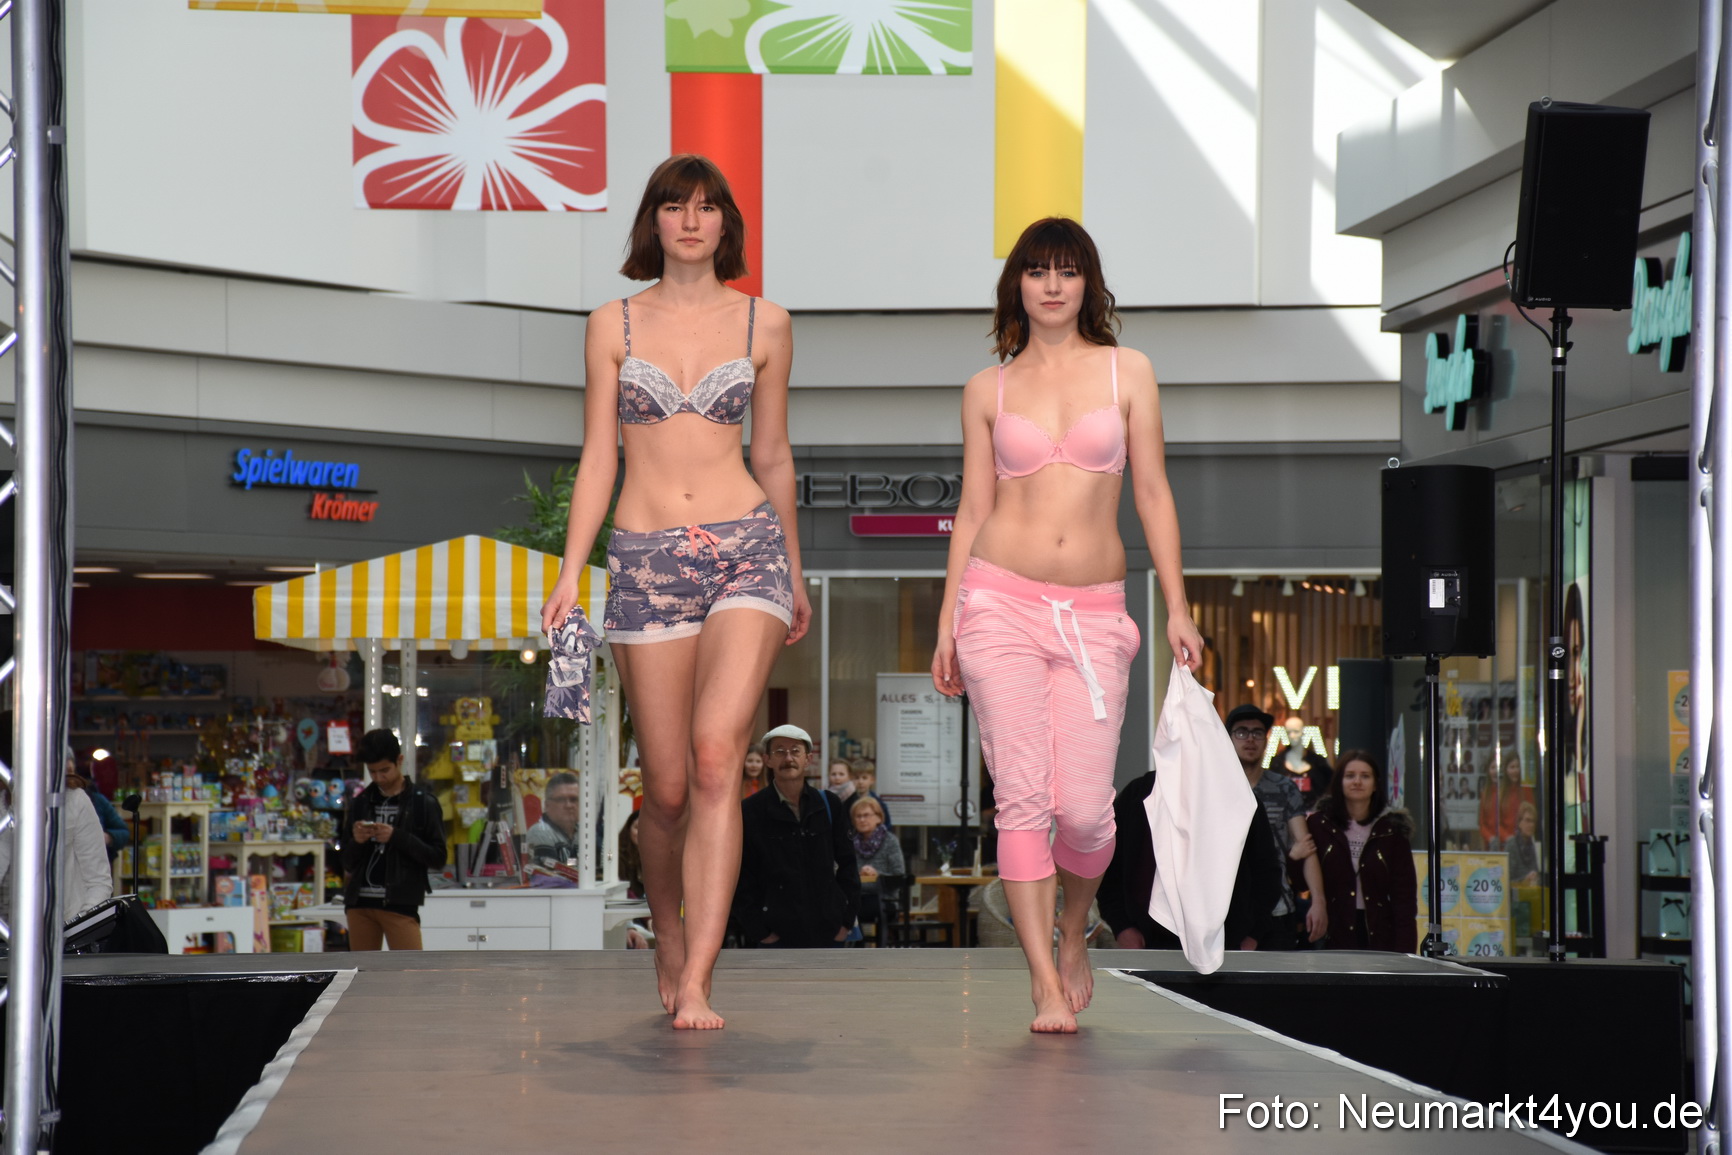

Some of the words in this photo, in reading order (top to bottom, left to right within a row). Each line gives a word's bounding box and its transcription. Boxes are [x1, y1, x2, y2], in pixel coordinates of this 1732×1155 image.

[233, 448, 360, 490] Spielwaren
[310, 493, 379, 522] Krömer
[881, 693, 917, 703] ALLES
